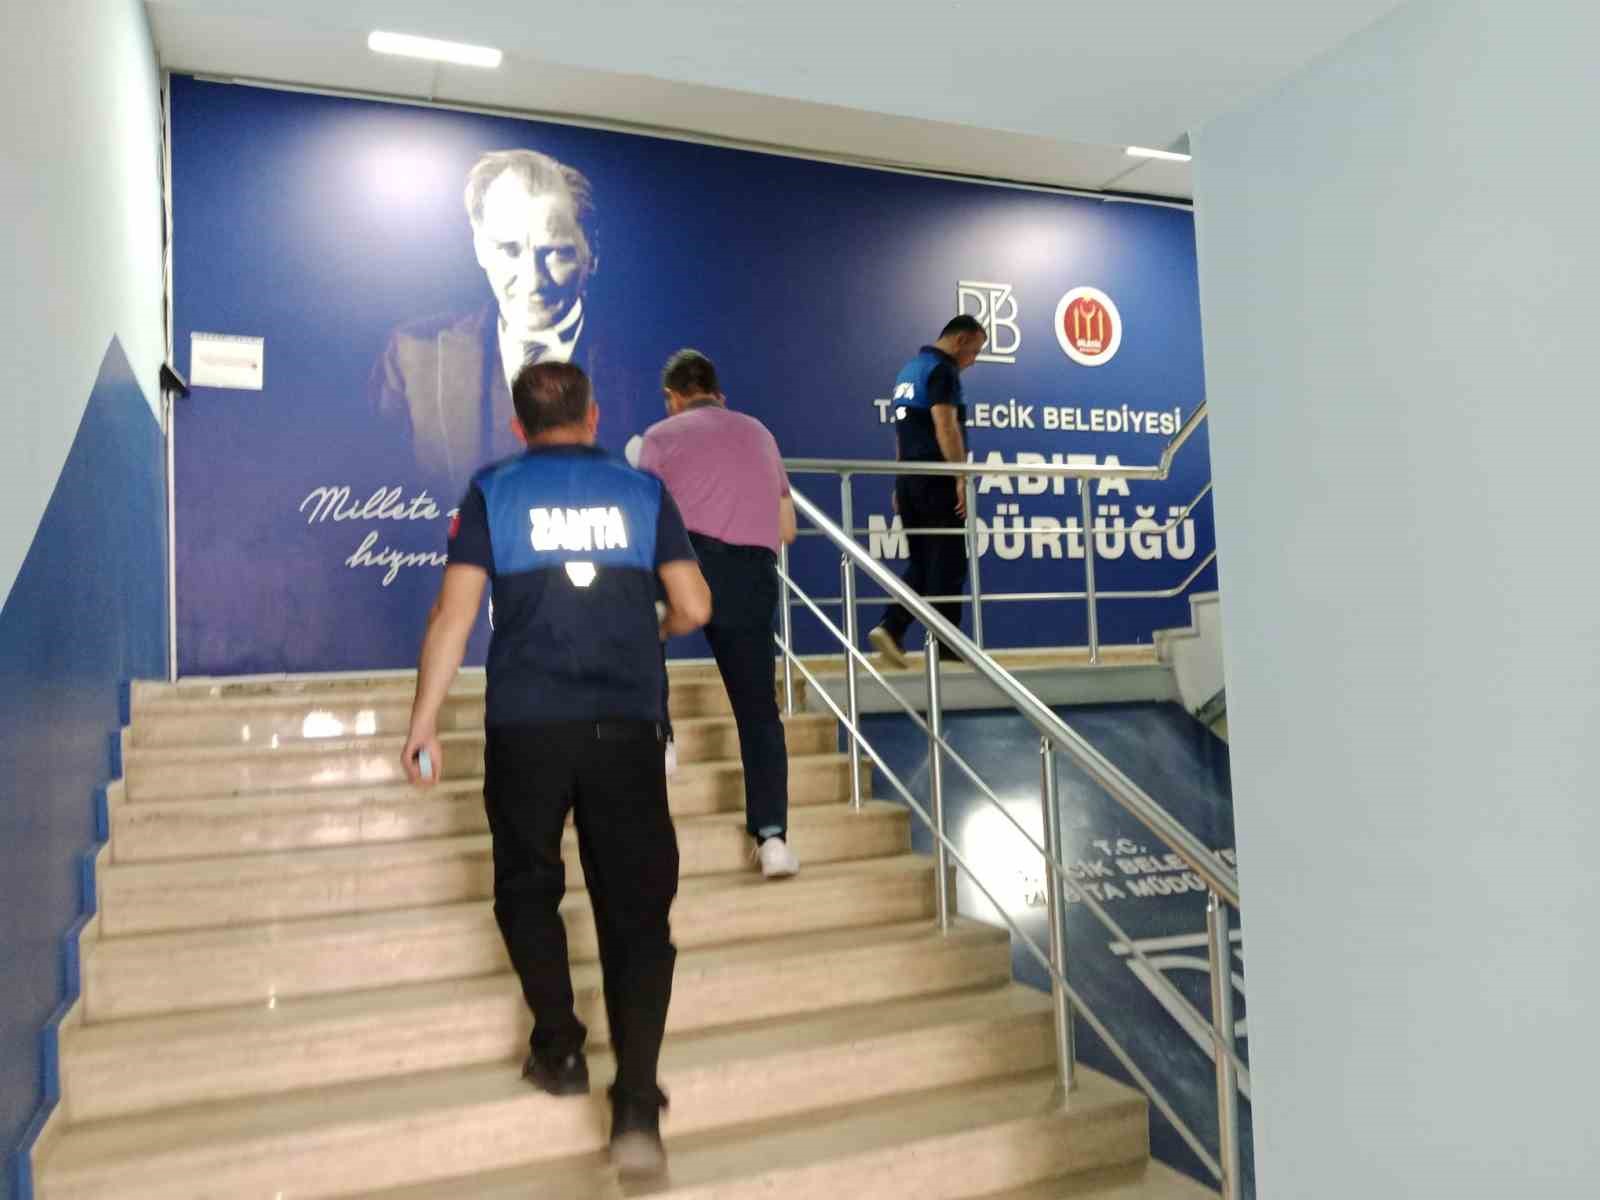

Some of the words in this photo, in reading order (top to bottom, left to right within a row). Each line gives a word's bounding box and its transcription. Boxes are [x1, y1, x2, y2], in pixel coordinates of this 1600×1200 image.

[964, 398, 1036, 429] ECİK
[1043, 403, 1181, 435] BELEDİYESİ
[967, 451, 1131, 496] ABITA
[300, 485, 441, 524] Millete
[868, 503, 1196, 561] MDÜRLÜĞÜ
[345, 530, 448, 587] hizm
